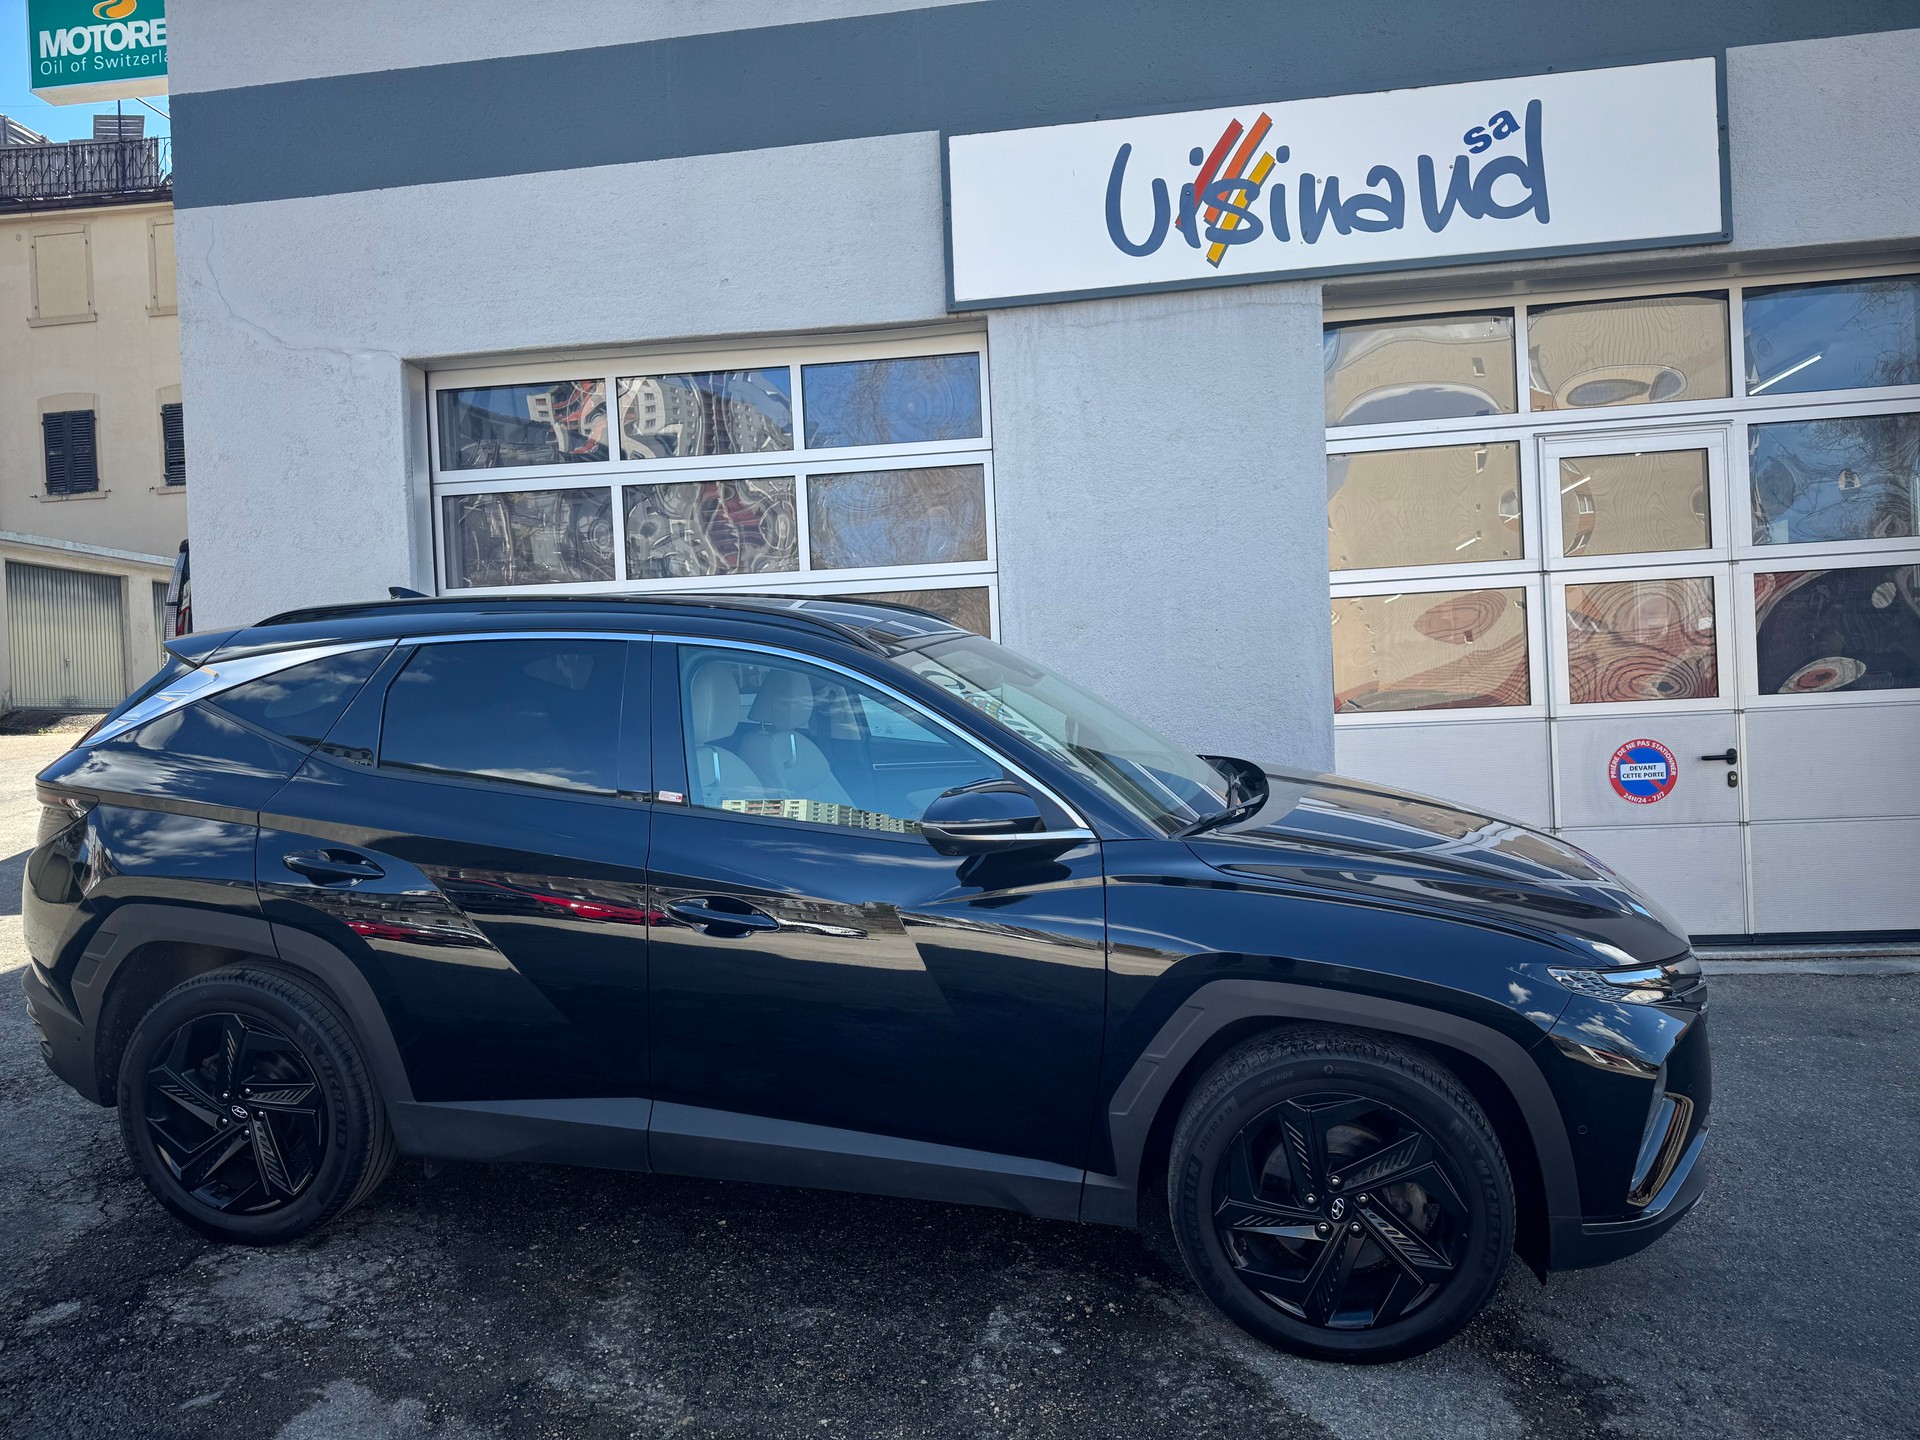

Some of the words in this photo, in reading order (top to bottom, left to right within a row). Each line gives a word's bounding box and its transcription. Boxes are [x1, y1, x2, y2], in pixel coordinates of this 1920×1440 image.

[40, 60, 63, 75] Oil
[70, 57, 87, 73] of
[1463, 110, 1521, 154] sa
[1617, 748, 1627, 757] DE
[1626, 741, 1636, 750] NE
[1651, 742, 1677, 776] STATIONNER
[1623, 792, 1647, 804] 24H/24
[1260, 1070, 1295, 1087] OUTSIDE
